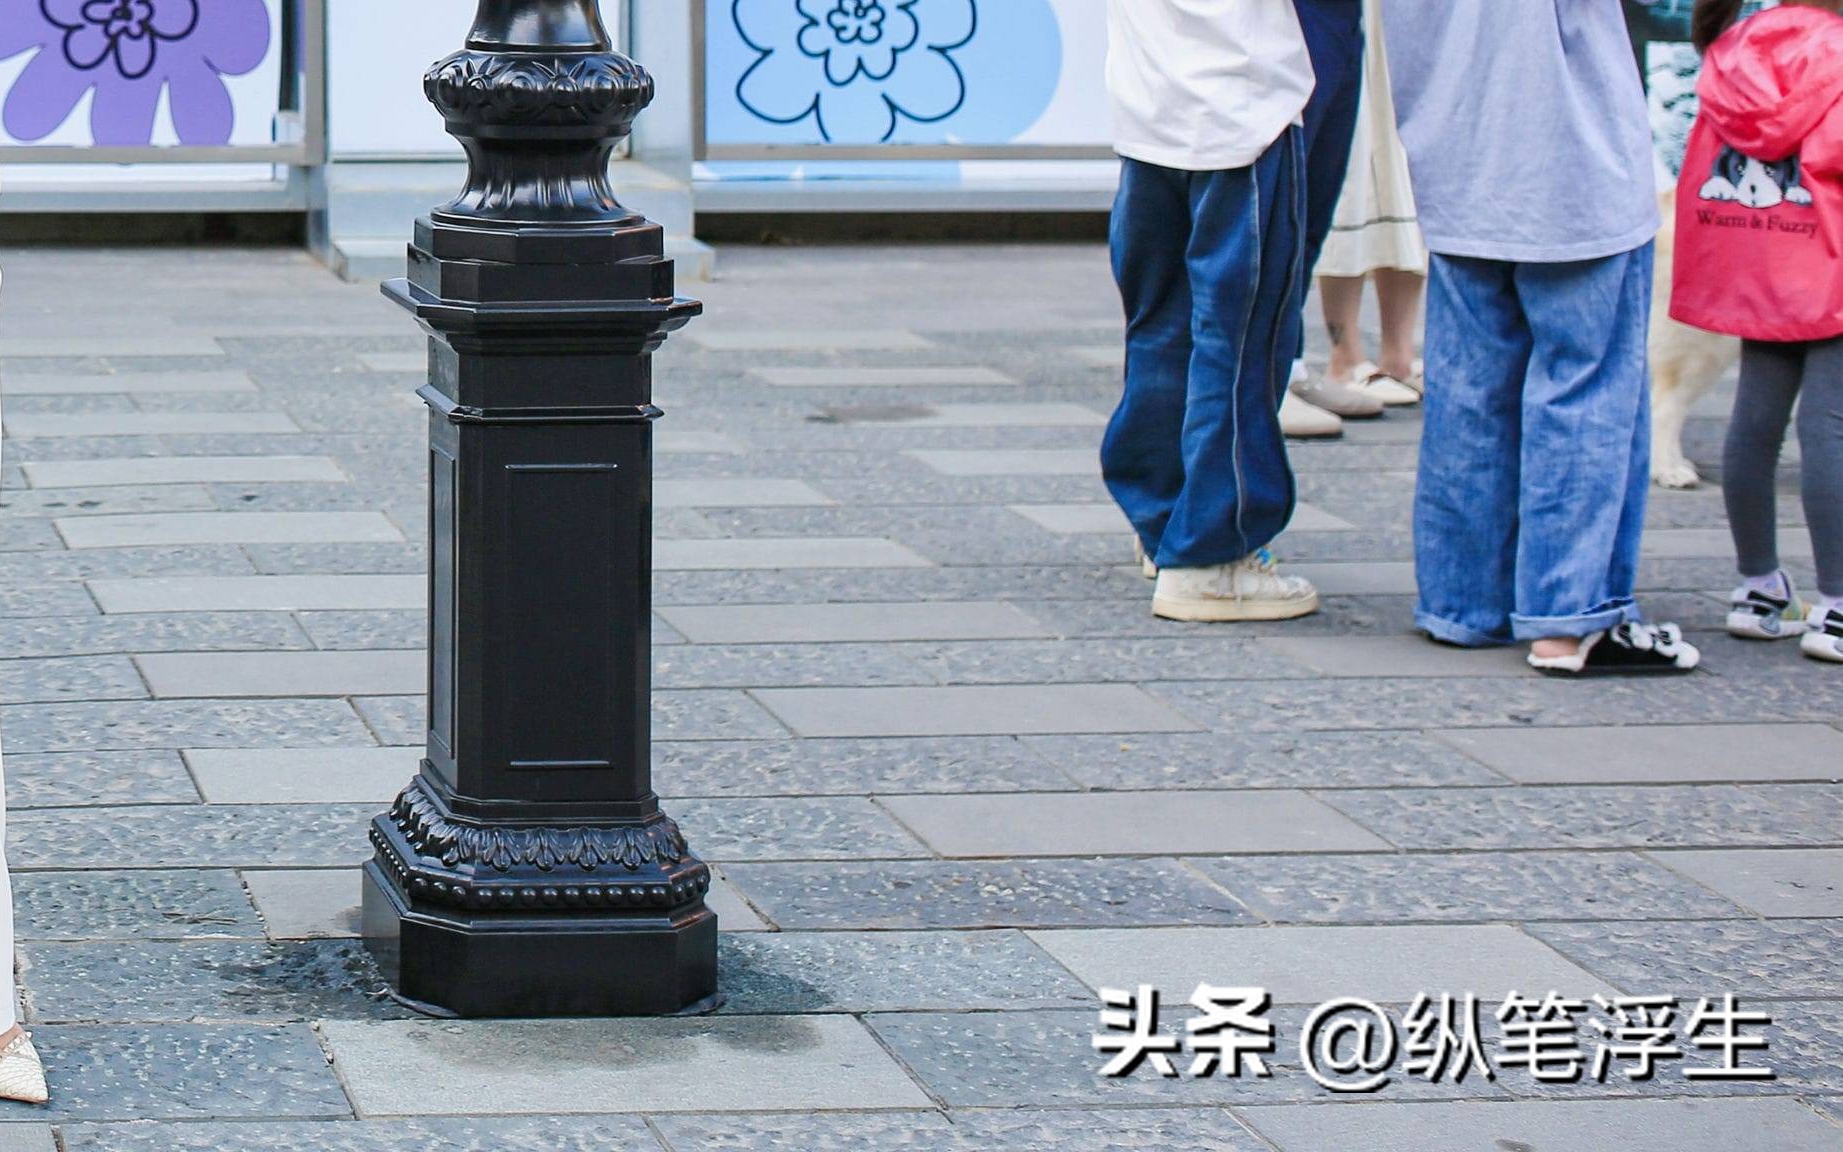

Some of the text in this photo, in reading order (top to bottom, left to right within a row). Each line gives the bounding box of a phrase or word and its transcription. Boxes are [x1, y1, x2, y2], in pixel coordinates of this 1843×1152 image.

[1696, 209, 1819, 239] Warm & Fuzzy
